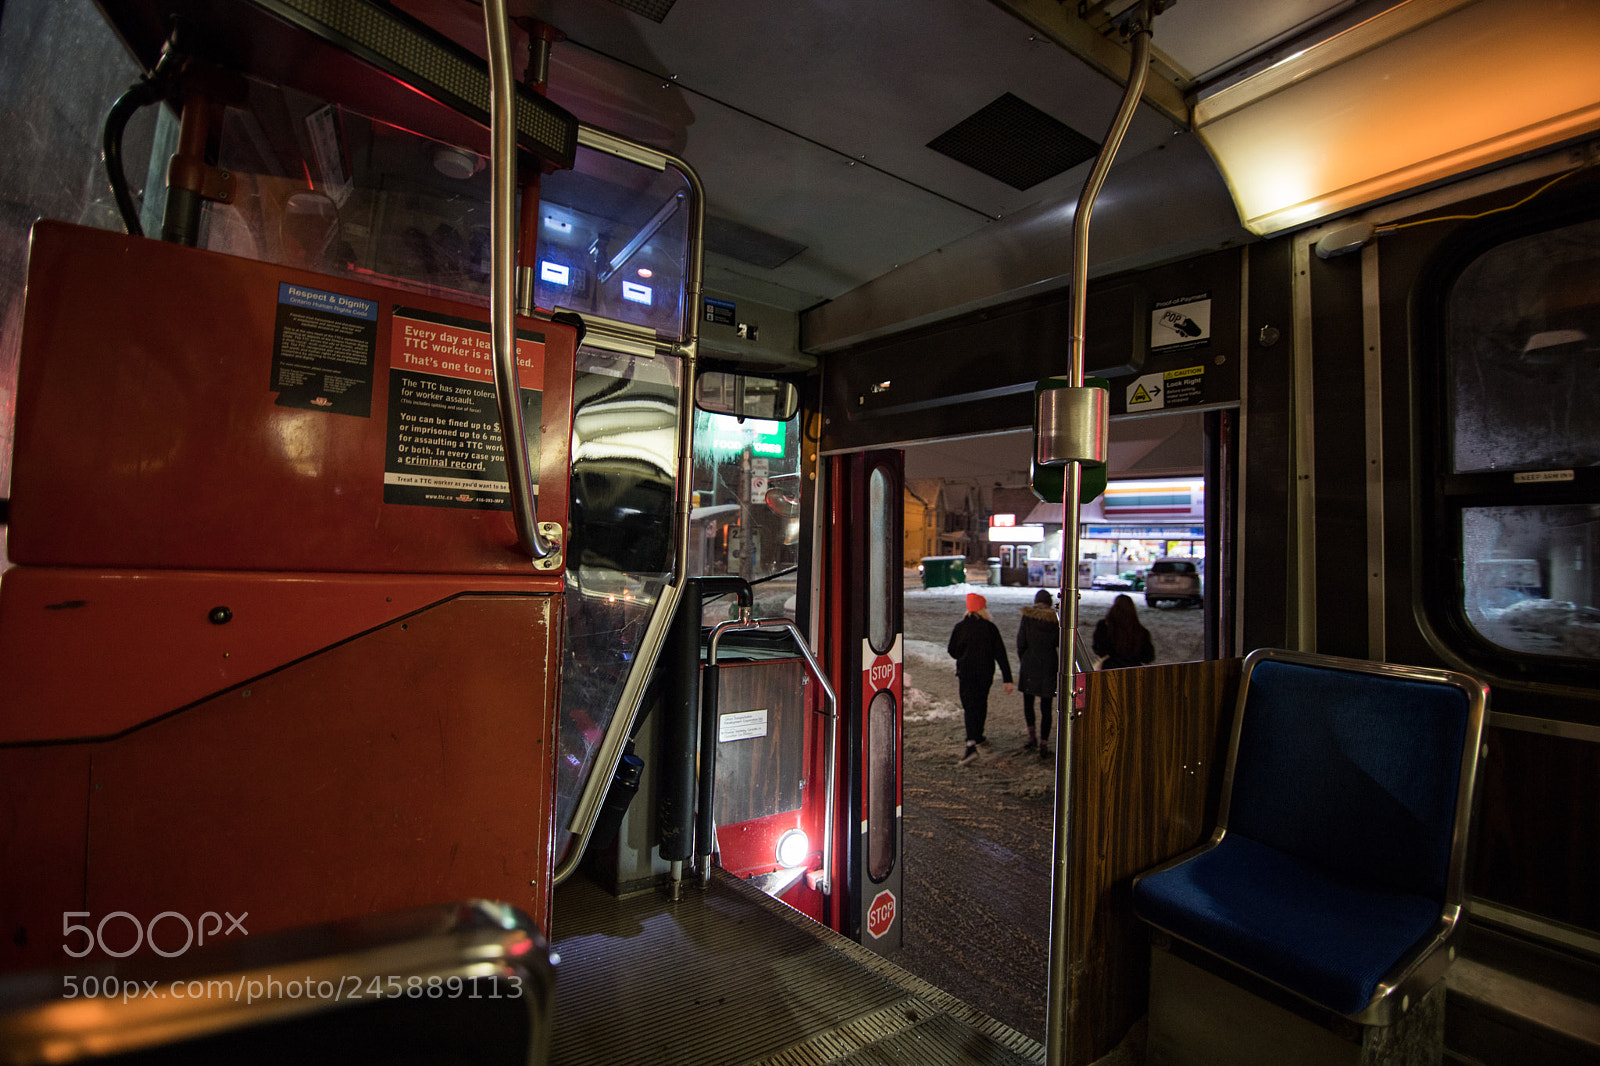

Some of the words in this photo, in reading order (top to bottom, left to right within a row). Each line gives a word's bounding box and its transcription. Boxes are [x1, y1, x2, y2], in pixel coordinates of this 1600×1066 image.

[289, 287, 327, 302] Respect
[329, 295, 336, 303] &
[338, 297, 370, 311] Dignity
[1163, 311, 1182, 323] POP
[404, 325, 436, 341] Every
[440, 331, 459, 345] day
[462, 336, 473, 347] at
[475, 338, 491, 350] lea
[404, 337, 428, 350] TTC
[432, 343, 470, 358] worker
[473, 347, 481, 359] is
[403, 353, 438, 367] That's
[442, 361, 461, 371] one
[464, 364, 482, 375] too
[1174, 368, 1202, 376] CAUTION
[402, 378, 418, 388] The
[420, 380, 437, 391] TTC
[439, 383, 453, 393] has
[455, 387, 472, 396] zero
[474, 389, 496, 399] tolera
[1183, 378, 1201, 386] Right
[401, 388, 413, 397] for
[416, 390, 444, 401] worker
[446, 395, 475, 405] assault.
[400, 412, 417, 422] You
[419, 416, 434, 425] can
[436, 417, 447, 426] be
[449, 419, 469, 428] fined
[471, 421, 481, 431] up
[483, 421, 492, 431] to
[399, 433, 412, 442] for
[414, 437, 458, 448] assaulting
[466, 440, 484, 451] TTC
[411, 425, 458, 437] imprisoned
[460, 429, 470, 439] up
[472, 431, 481, 440] to
[482, 432, 489, 441] 6
[398, 443, 409, 452] Or
[411, 445, 434, 456] both.
[436, 448, 445, 457] In
[447, 449, 470, 460] every
[471, 452, 489, 461] case
[405, 455, 449, 468] criminal
[450, 459, 486, 471] record.
[872, 664, 893, 681] STOP
[870, 901, 893, 928] STOP
